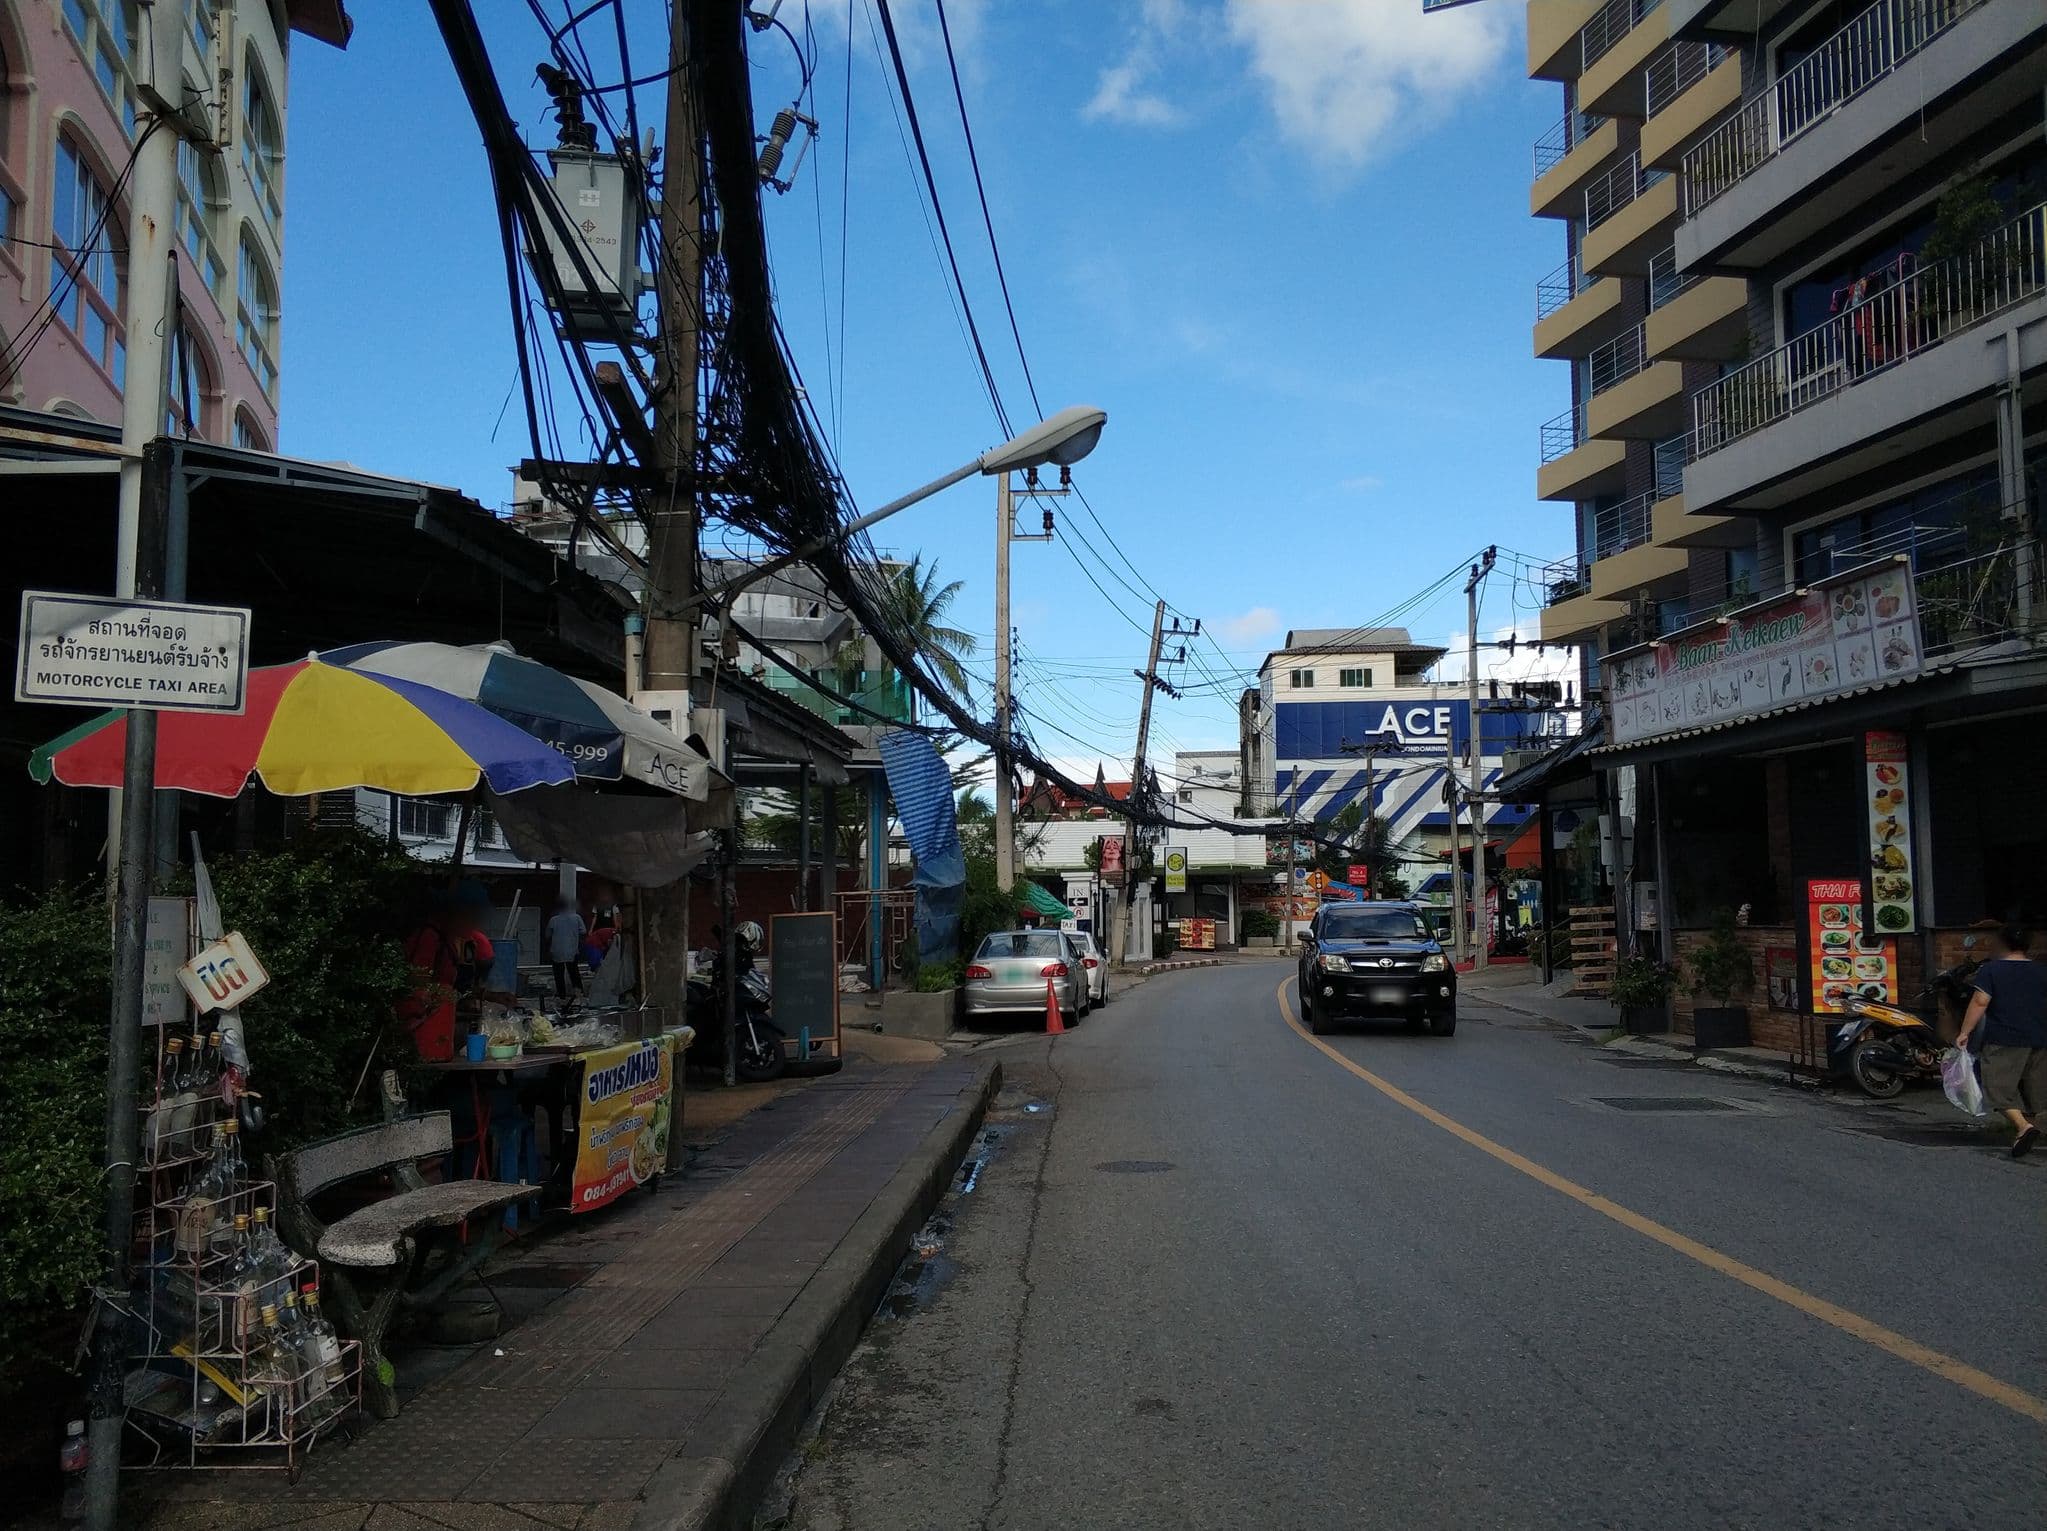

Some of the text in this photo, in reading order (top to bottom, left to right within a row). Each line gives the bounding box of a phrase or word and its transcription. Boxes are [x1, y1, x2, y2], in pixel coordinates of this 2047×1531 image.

[88, 612, 187, 641] สถานที่จอด
[39, 638, 228, 669] รถจักรยานยนต์รับจ้าง
[37, 672, 228, 695] MOTORCYCLE TAXI AREA
[1365, 705, 1450, 744] ACE
[645, 753, 689, 792] ACE
[1812, 884, 1861, 898] THAI F
